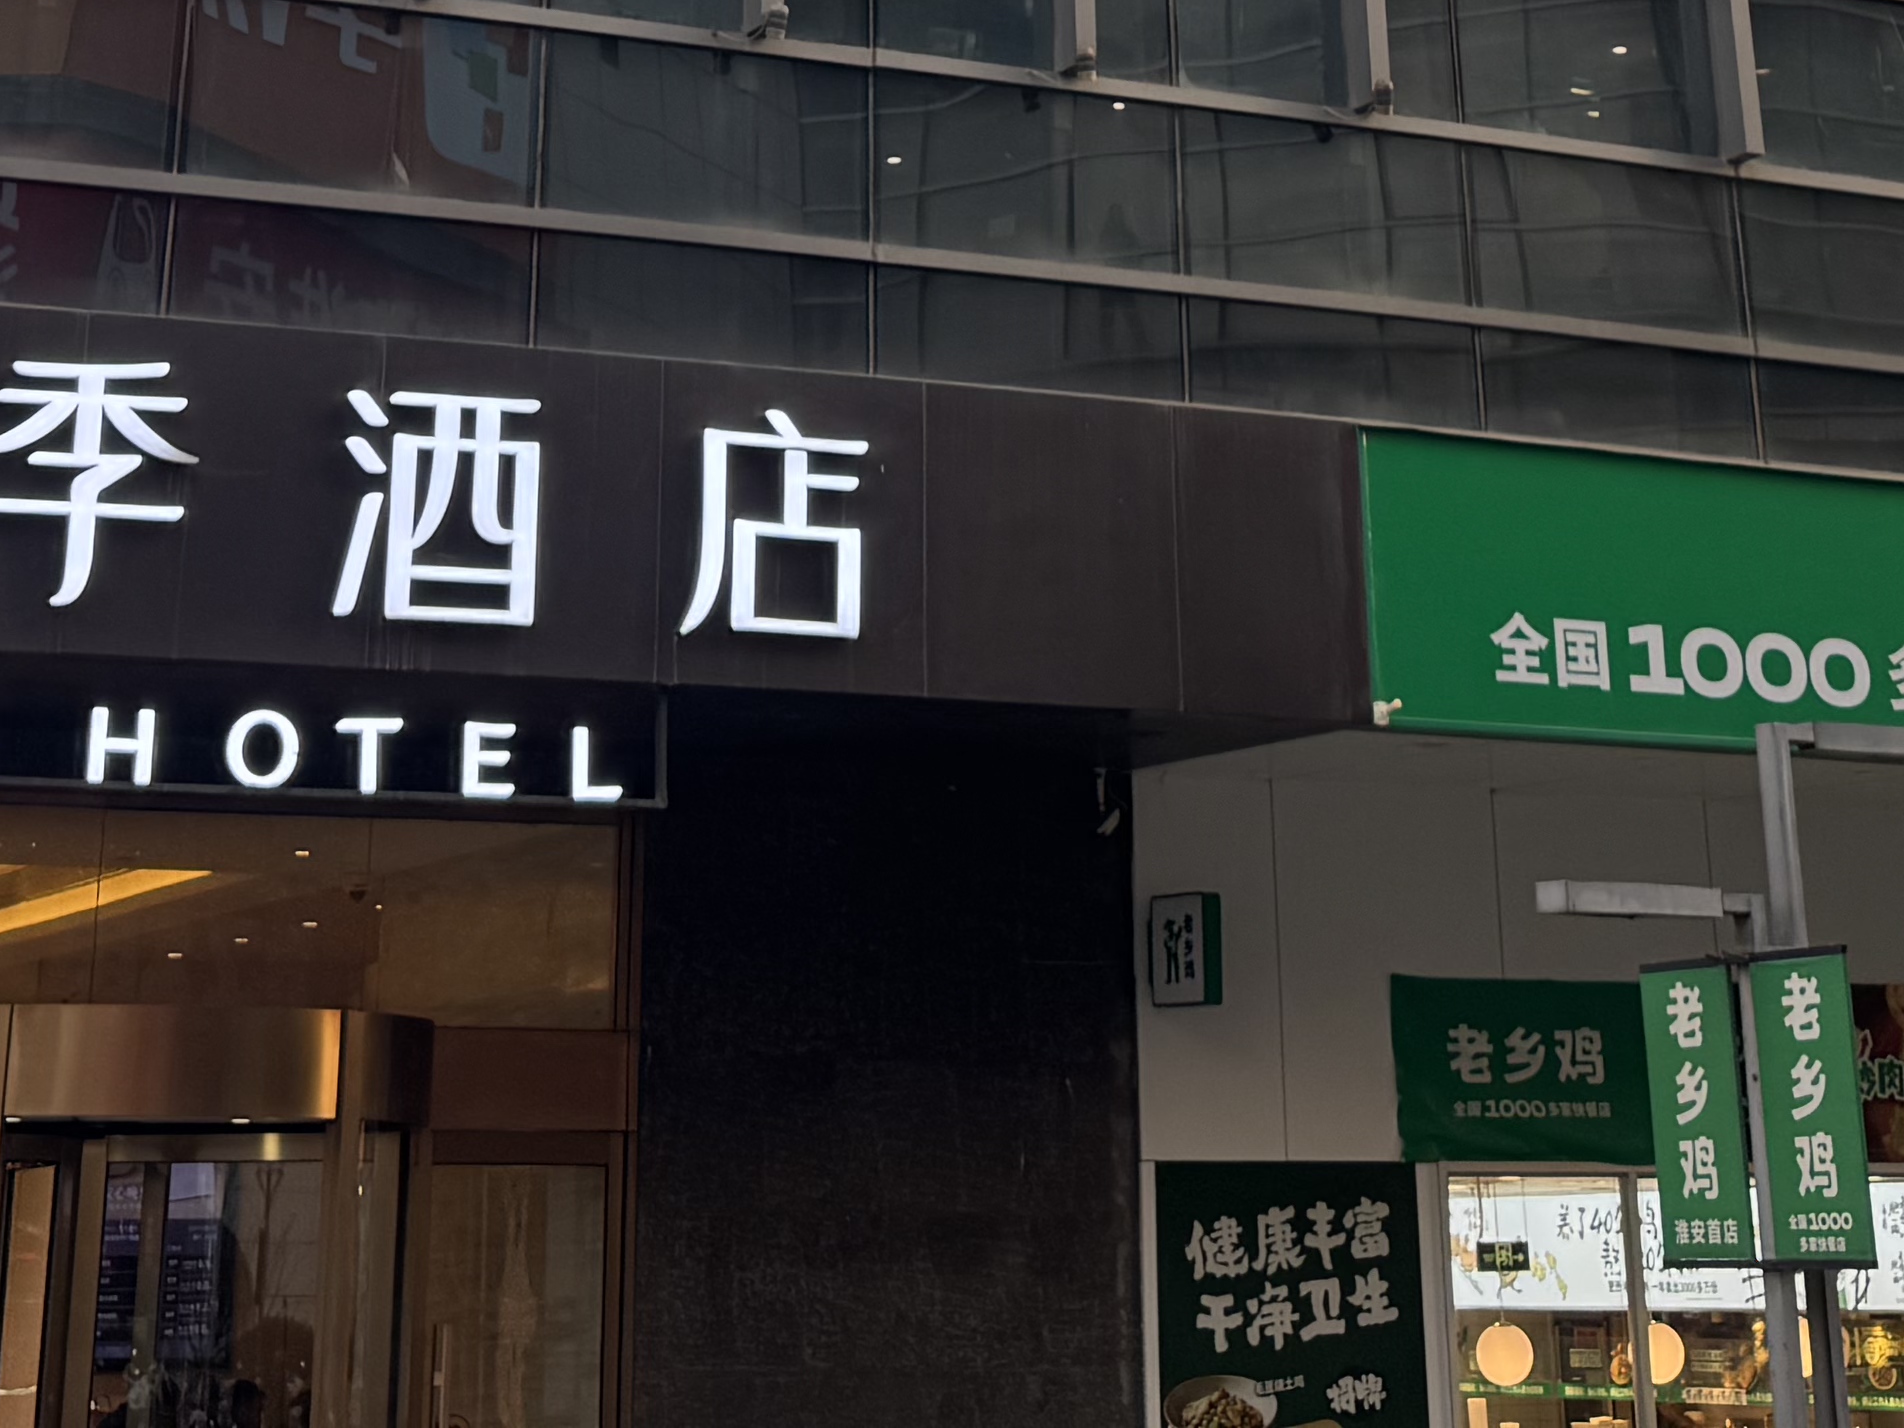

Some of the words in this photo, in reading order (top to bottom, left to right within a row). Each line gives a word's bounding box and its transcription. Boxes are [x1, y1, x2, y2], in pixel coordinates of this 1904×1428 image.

[86, 705, 624, 804] HOTEL
[1446, 1023, 1606, 1085] 老乡鸡
[1666, 981, 1720, 1201] 老乡鸡
[1781, 972, 1839, 1198] 老乡鸡
[1185, 1196, 1390, 1281] 健康丰富
[1674, 1219, 1739, 1246] 淮安首店
[1788, 1212, 1853, 1232] 全国1000
[1196, 1267, 1400, 1354] 干净卫生
